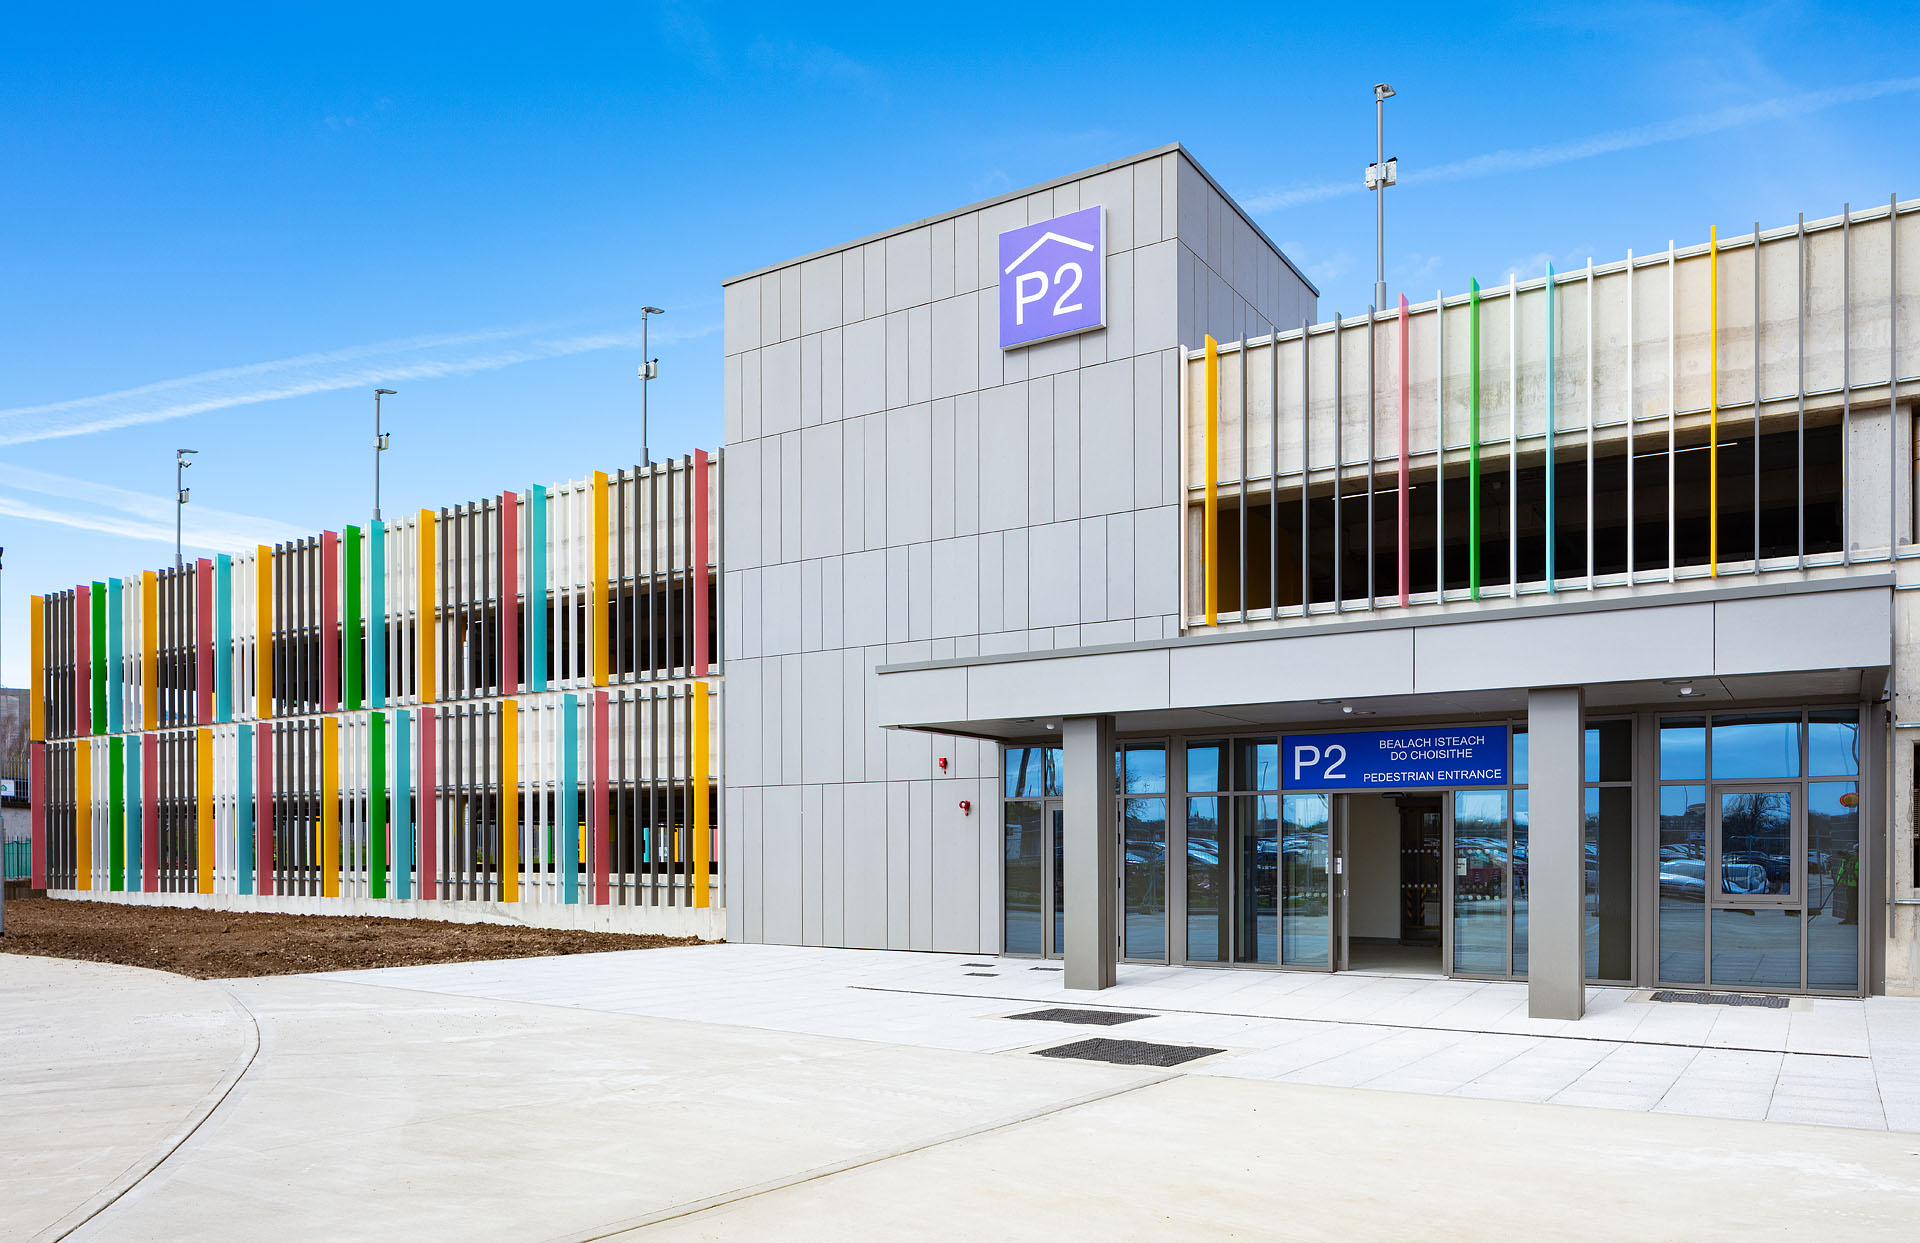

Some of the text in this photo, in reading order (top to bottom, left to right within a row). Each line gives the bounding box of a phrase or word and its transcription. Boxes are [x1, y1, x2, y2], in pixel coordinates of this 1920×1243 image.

[1016, 262, 1083, 326] P2
[1379, 735, 1485, 749] BEALACH ISTEACH
[1390, 748, 1473, 761] DO CHOISITHE
[1294, 744, 1347, 781] P2
[1363, 769, 1502, 783] PEDESTRIAN ENTRANCE
